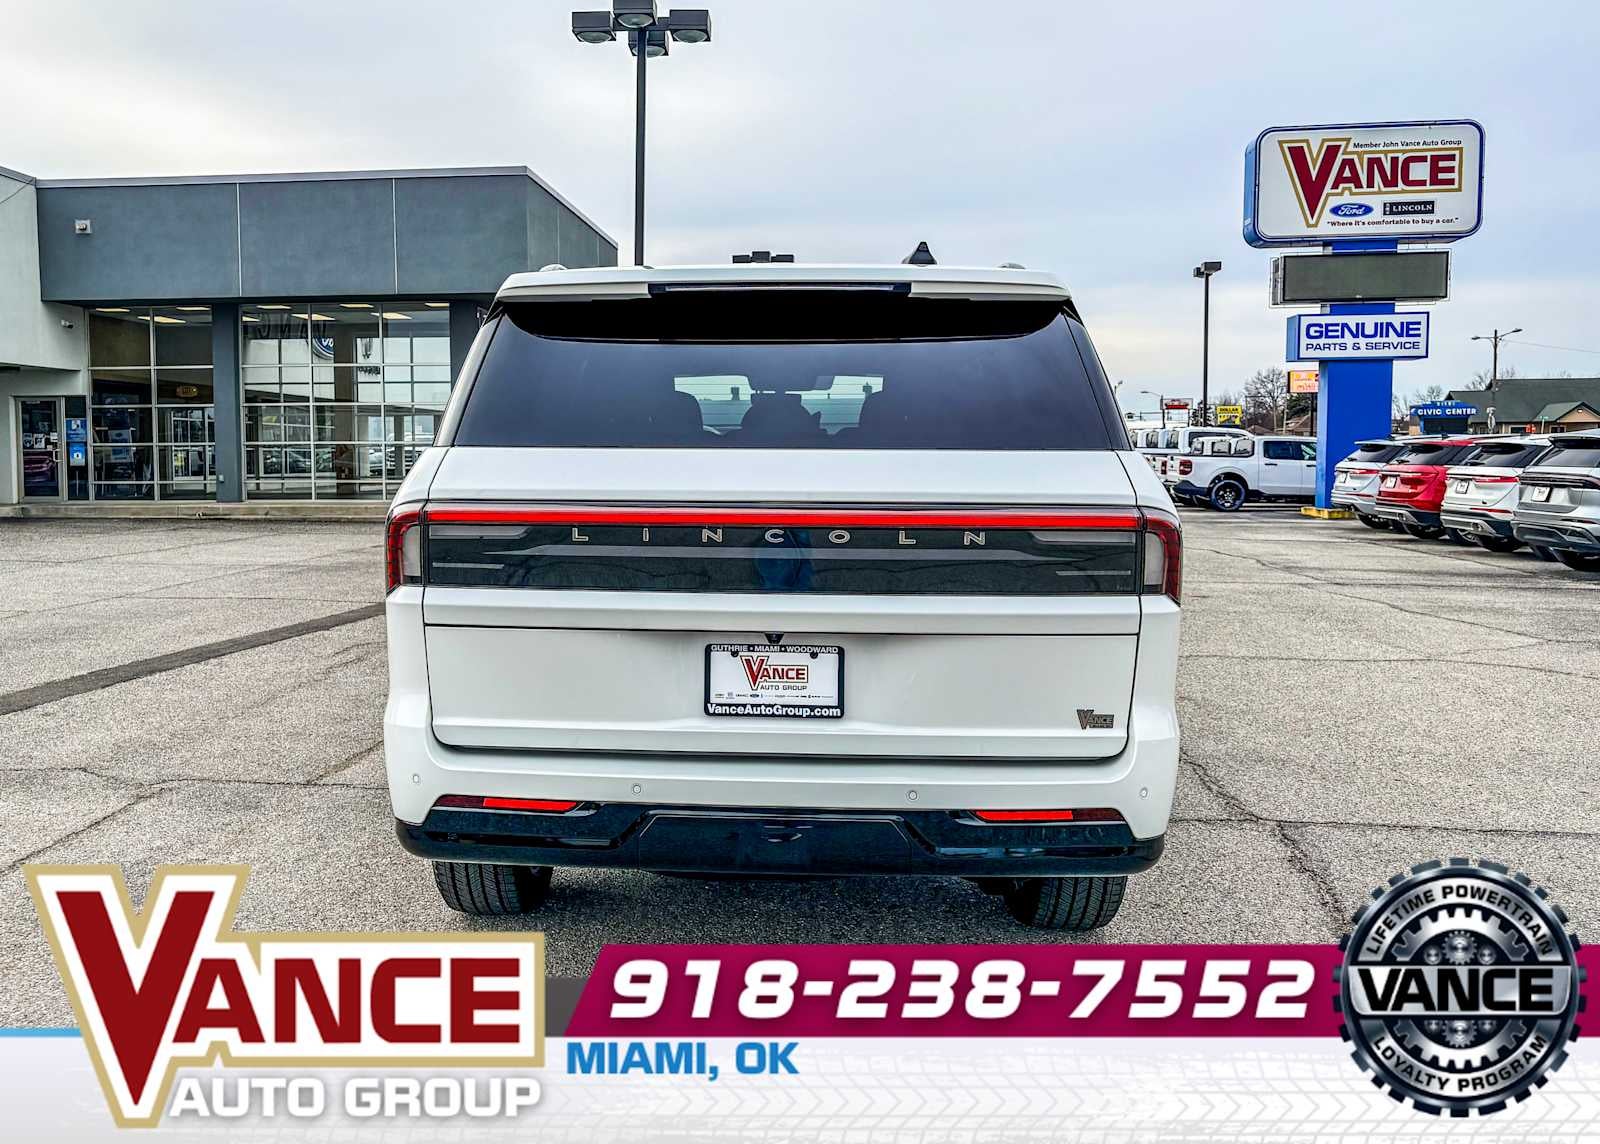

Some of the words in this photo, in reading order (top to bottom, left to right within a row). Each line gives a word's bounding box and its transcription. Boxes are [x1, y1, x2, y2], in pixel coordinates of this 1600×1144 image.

[1353, 141, 1381, 149] Member
[1287, 144, 1457, 220] VANCE
[1338, 204, 1365, 215] Ford
[1392, 203, 1433, 212] LINCOLN
[1367, 218, 1410, 226] comfortable
[1305, 320, 1422, 340] GENUINE
[1305, 342, 1347, 352] PARTS
[1352, 341, 1362, 351] &
[1365, 341, 1421, 351] SERVICE
[1417, 408, 1442, 416] CIVIC
[1445, 407, 1477, 415] CENTER
[572, 527, 986, 546] LINCOLN
[710, 644, 749, 652] GUTHRIE
[785, 646, 839, 654] WOODWARD
[744, 658, 806, 689] VANCE
[707, 703, 841, 717] VanceAutoGroup.com
